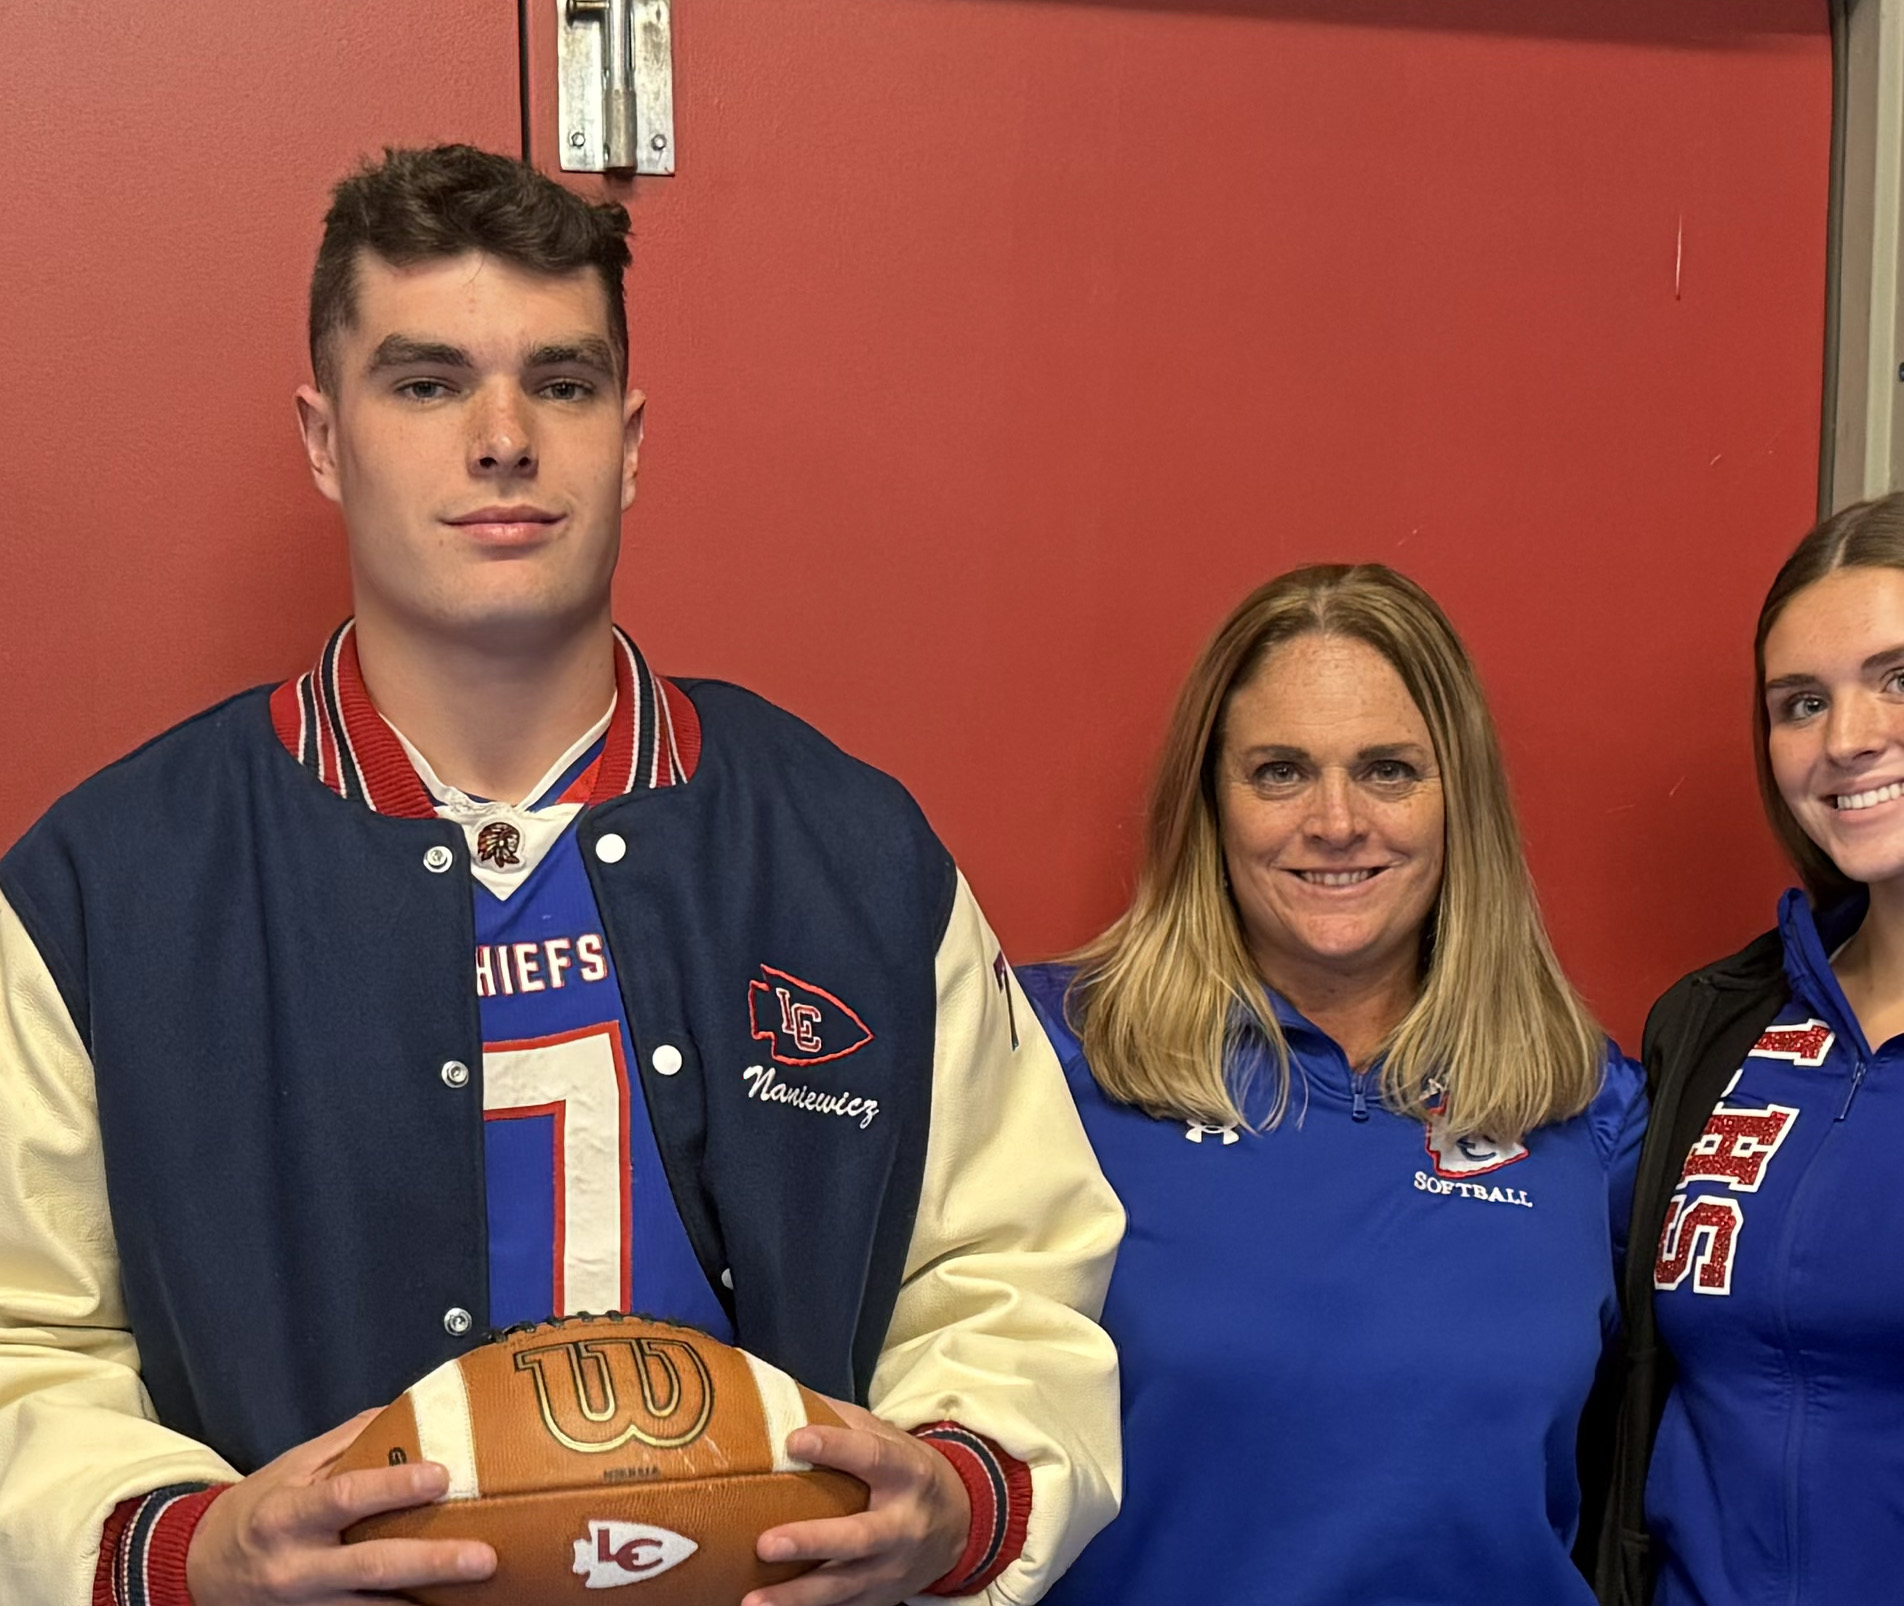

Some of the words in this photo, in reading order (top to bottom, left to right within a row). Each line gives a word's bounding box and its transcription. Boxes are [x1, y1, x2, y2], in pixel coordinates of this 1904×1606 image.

[475, 933, 609, 997] HIEFS
[776, 987, 822, 1053] LC
[742, 1064, 880, 1130] Naniewicz
[1413, 1170, 1534, 1208] SOFTBALL
[597, 1527, 664, 1573] LC
